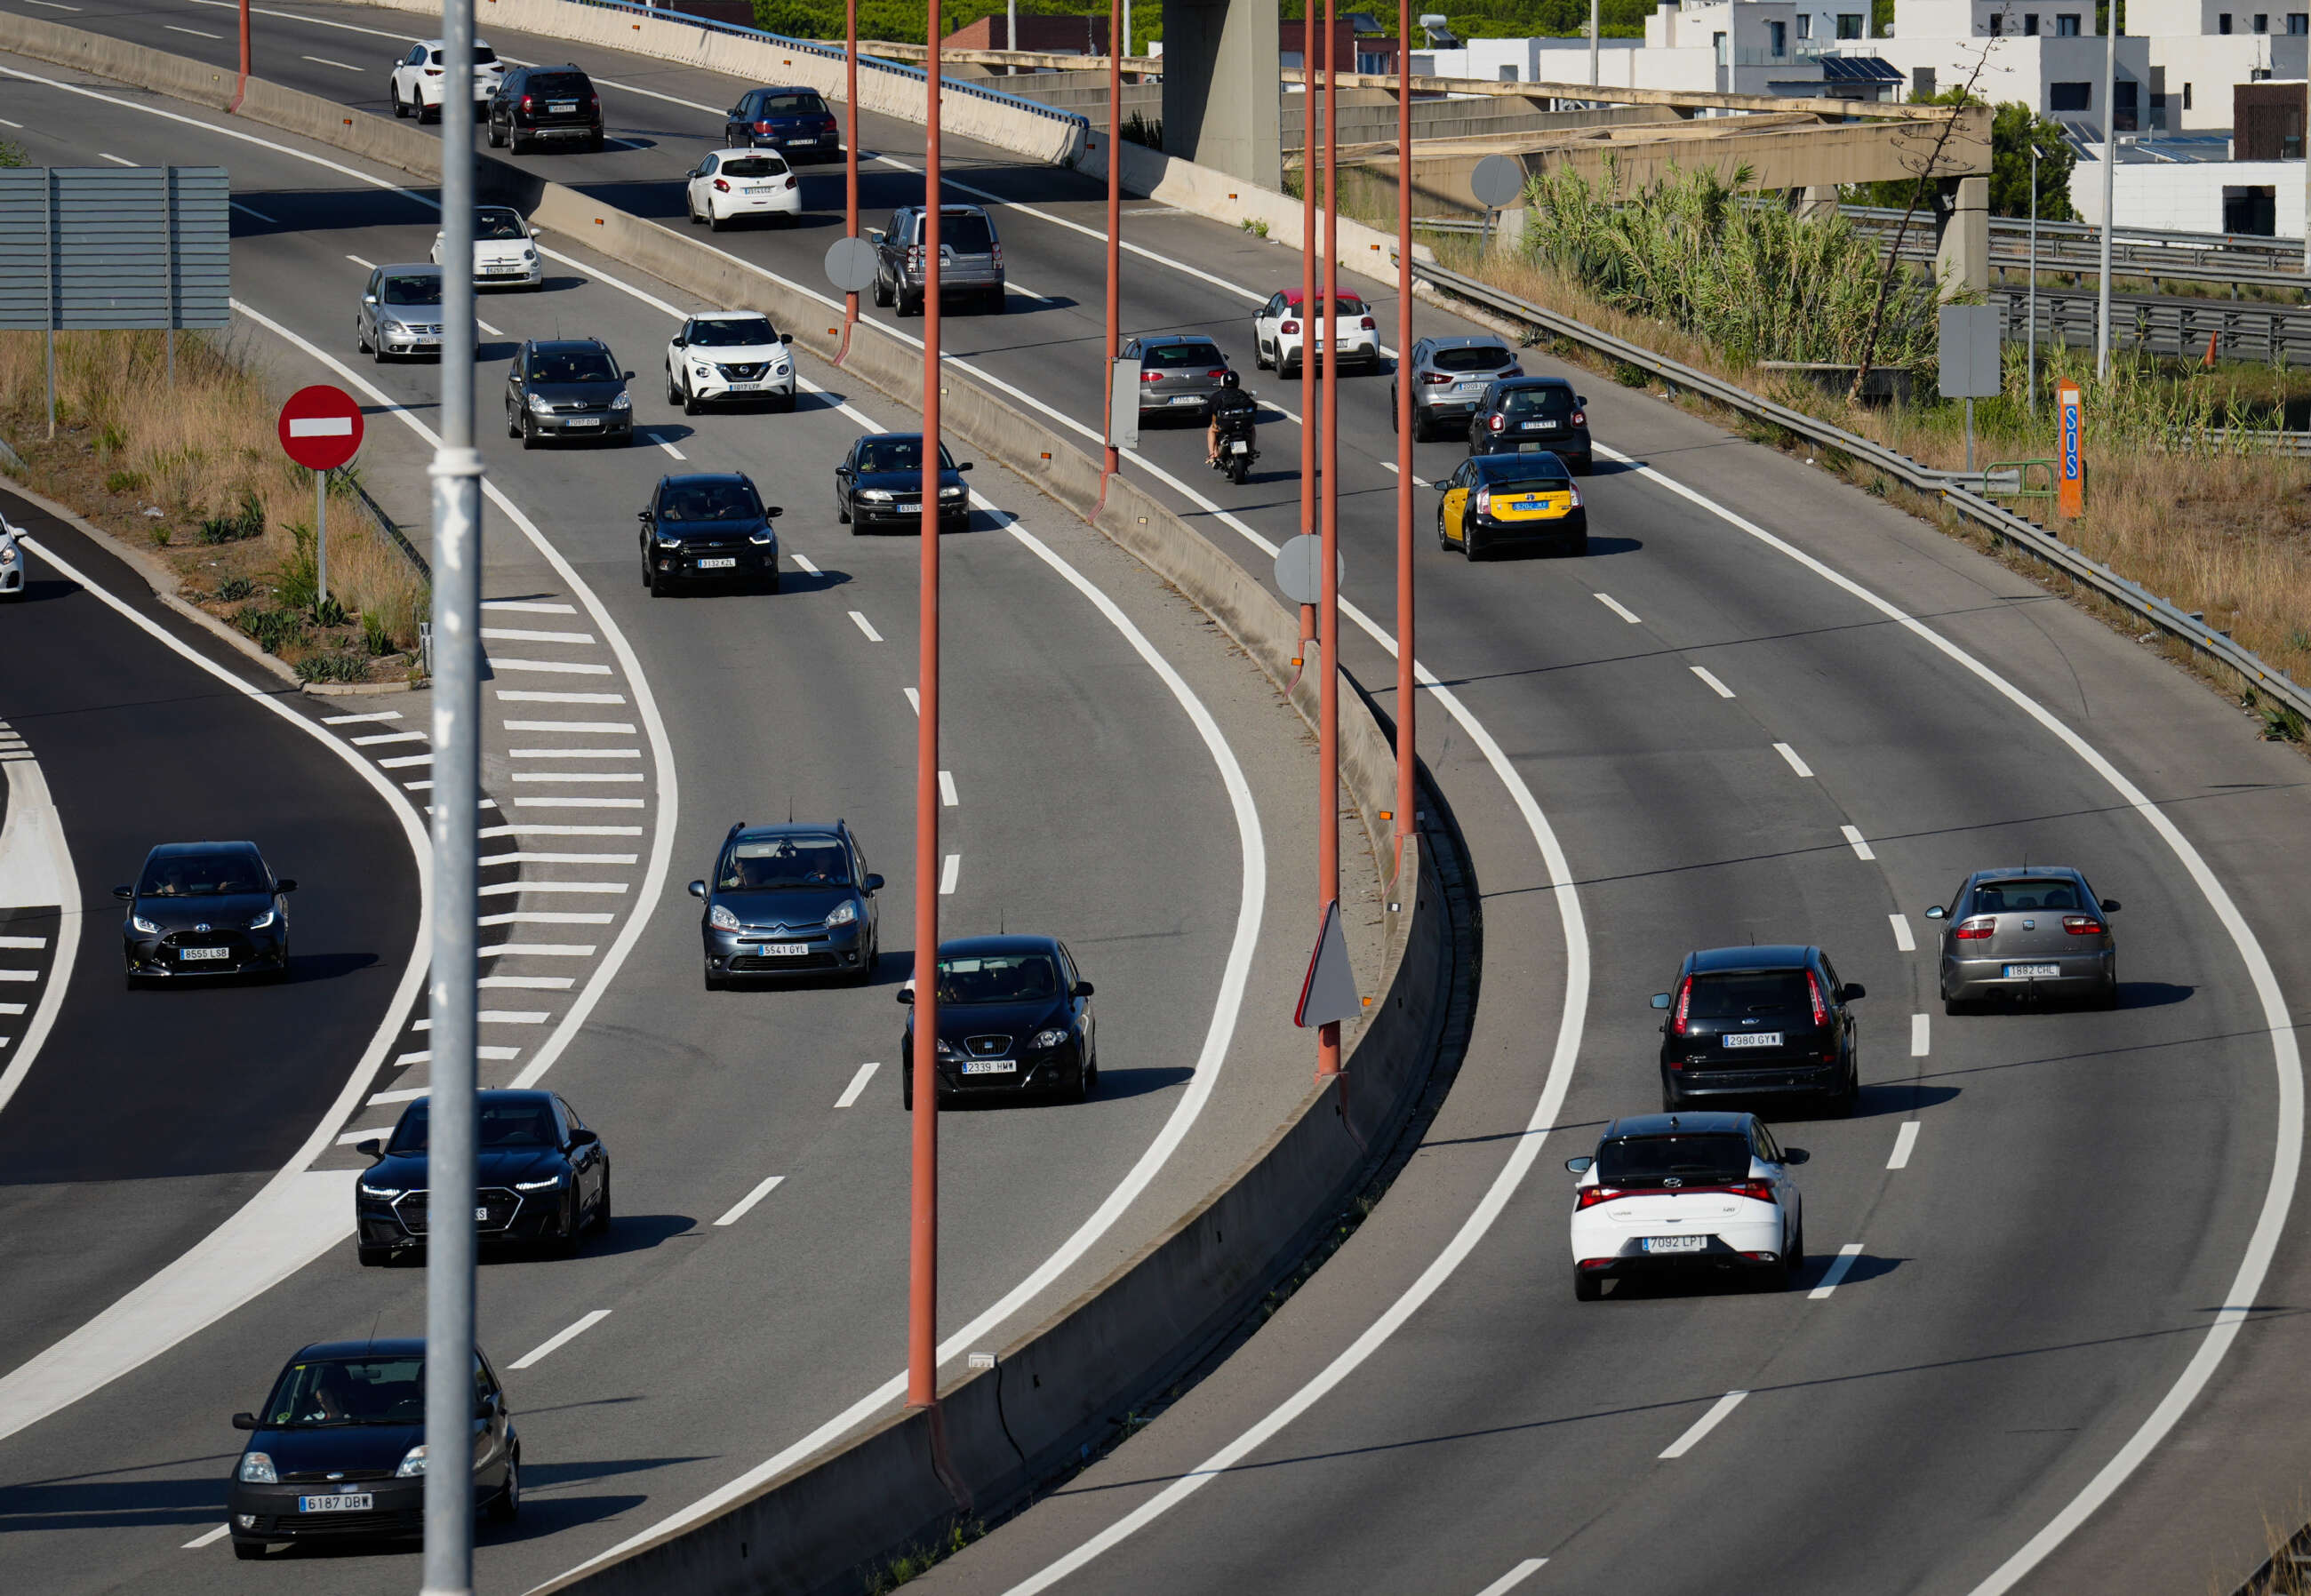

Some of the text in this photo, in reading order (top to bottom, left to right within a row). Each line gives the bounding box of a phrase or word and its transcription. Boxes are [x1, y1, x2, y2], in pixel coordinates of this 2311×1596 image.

[2067, 407, 2076, 477] SOS
[186, 947, 228, 959] 8555 LSB
[764, 945, 805, 954] 5541 GYL
[2036, 966, 2055, 975] CHL
[1730, 1034, 1776, 1045] 2980 GYW
[968, 1062, 1013, 1073] 2339 HMW
[1651, 1236, 1702, 1248] 7092 LPT
[308, 1495, 368, 1510] 6187 DBW
